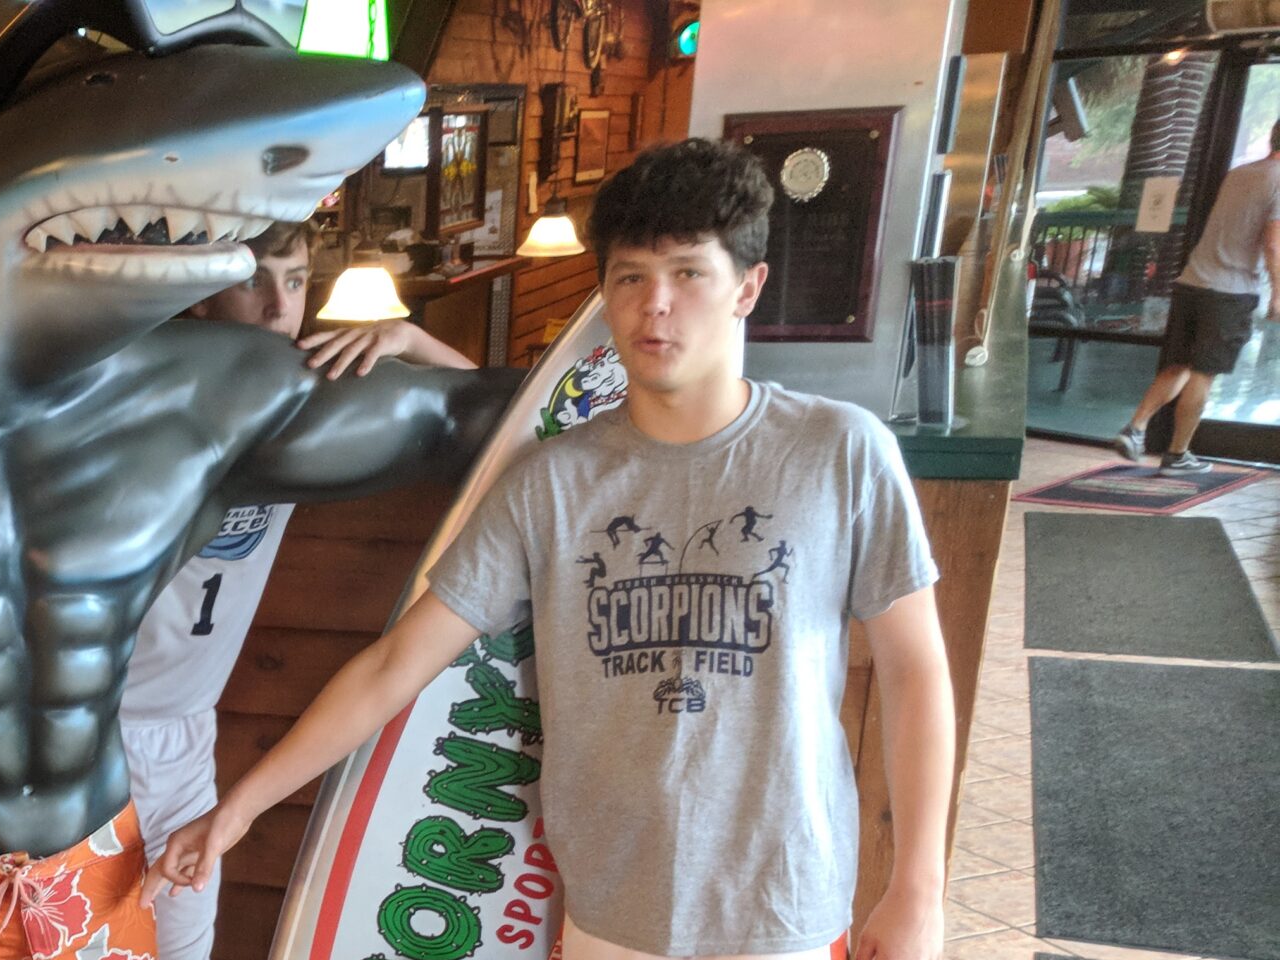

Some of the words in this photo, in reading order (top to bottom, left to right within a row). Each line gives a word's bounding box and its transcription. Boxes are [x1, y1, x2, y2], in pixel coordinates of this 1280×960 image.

[190, 572, 223, 636] 1
[587, 580, 773, 656] SCORPIONS
[602, 650, 667, 678] TRACK
[694, 650, 754, 678] FIELD
[652, 697, 707, 714] TCB
